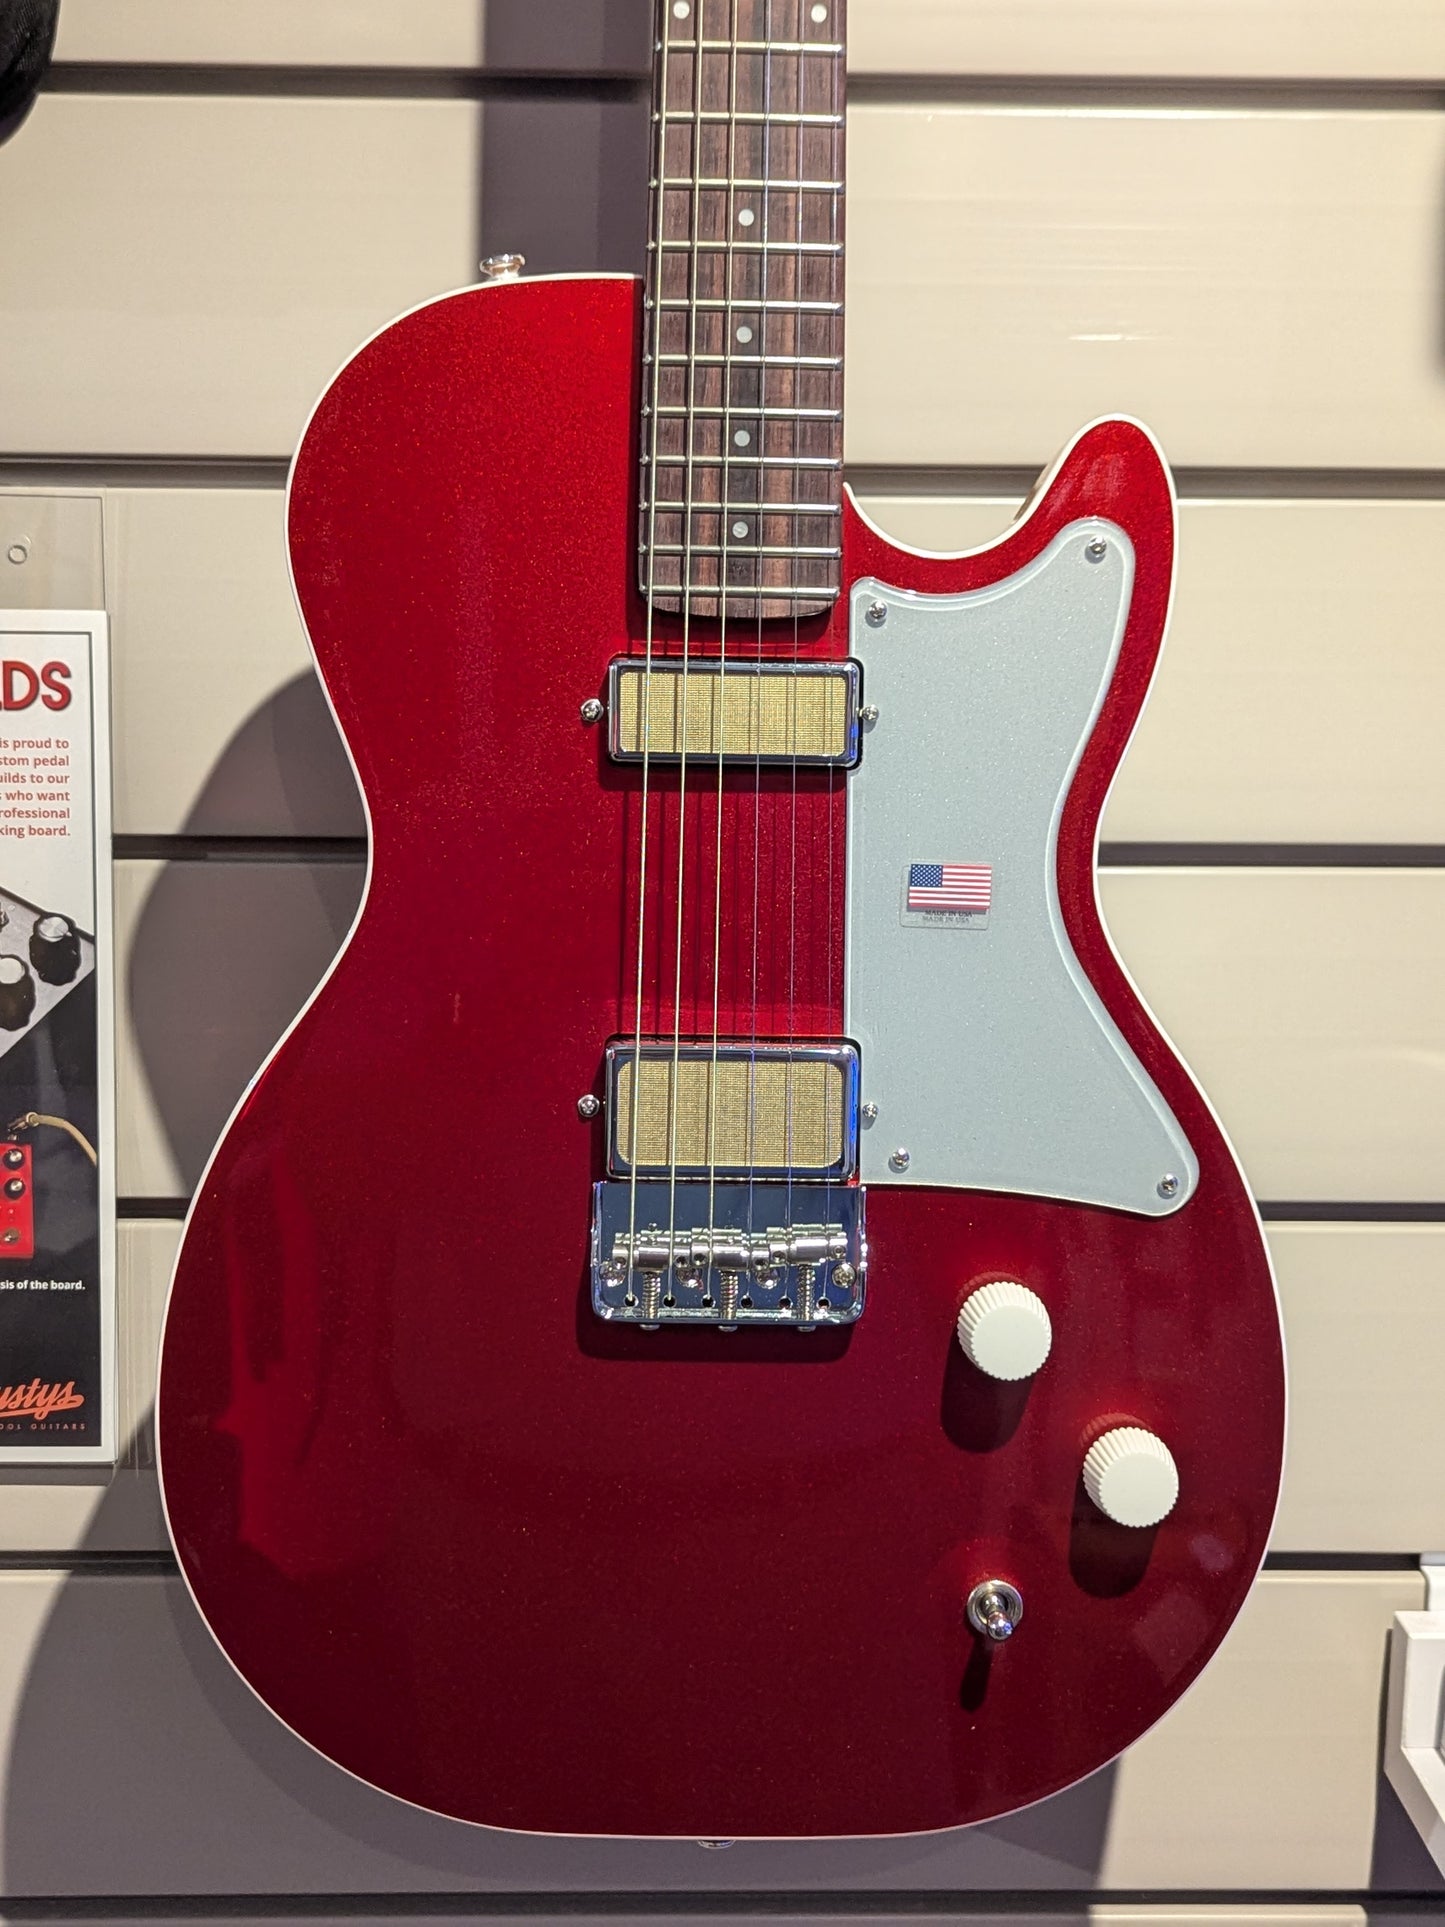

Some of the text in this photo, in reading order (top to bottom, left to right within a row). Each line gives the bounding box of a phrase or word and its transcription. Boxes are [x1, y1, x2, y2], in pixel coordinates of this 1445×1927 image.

[0, 660, 72, 711] DS
[13, 738, 52, 751] proud
[56, 739, 69, 749] to
[33, 755, 69, 769] pedal
[31, 774, 44, 783] to
[47, 775, 70, 784] our
[5, 790, 33, 801] who
[37, 792, 70, 801] want
[28, 825, 71, 836] board.
[16, 1280, 29, 1290] of
[30, 1280, 49, 1290] the
[50, 1280, 86, 1290] board.
